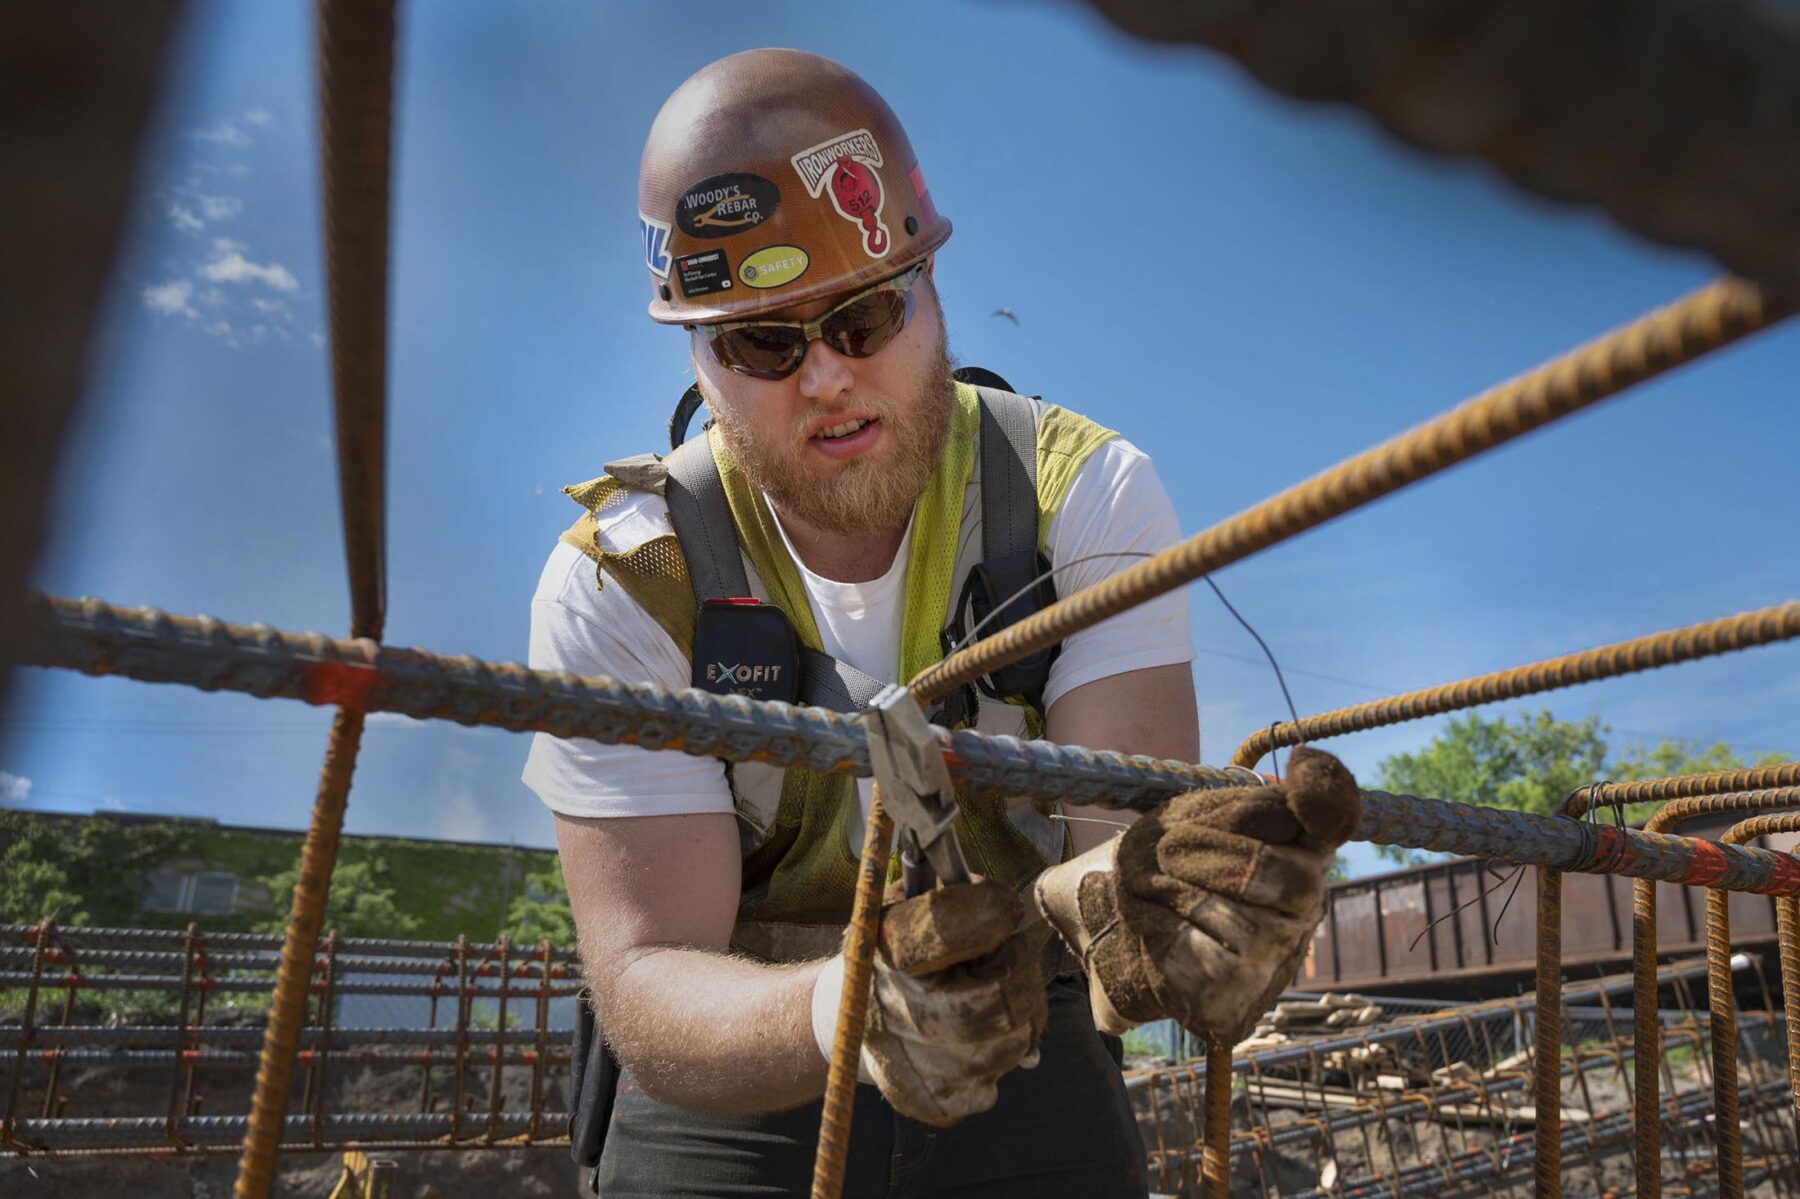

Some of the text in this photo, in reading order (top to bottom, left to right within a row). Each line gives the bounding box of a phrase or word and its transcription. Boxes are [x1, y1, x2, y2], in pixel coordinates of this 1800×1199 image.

[799, 134, 878, 187] IRONWORKERS
[686, 185, 740, 209] WOODY'S
[717, 198, 757, 216] REBAR
[848, 190, 873, 211] 512
[744, 211, 764, 223] CO.
[760, 255, 805, 276] SAFETY
[706, 662, 781, 684] EXOFIT
